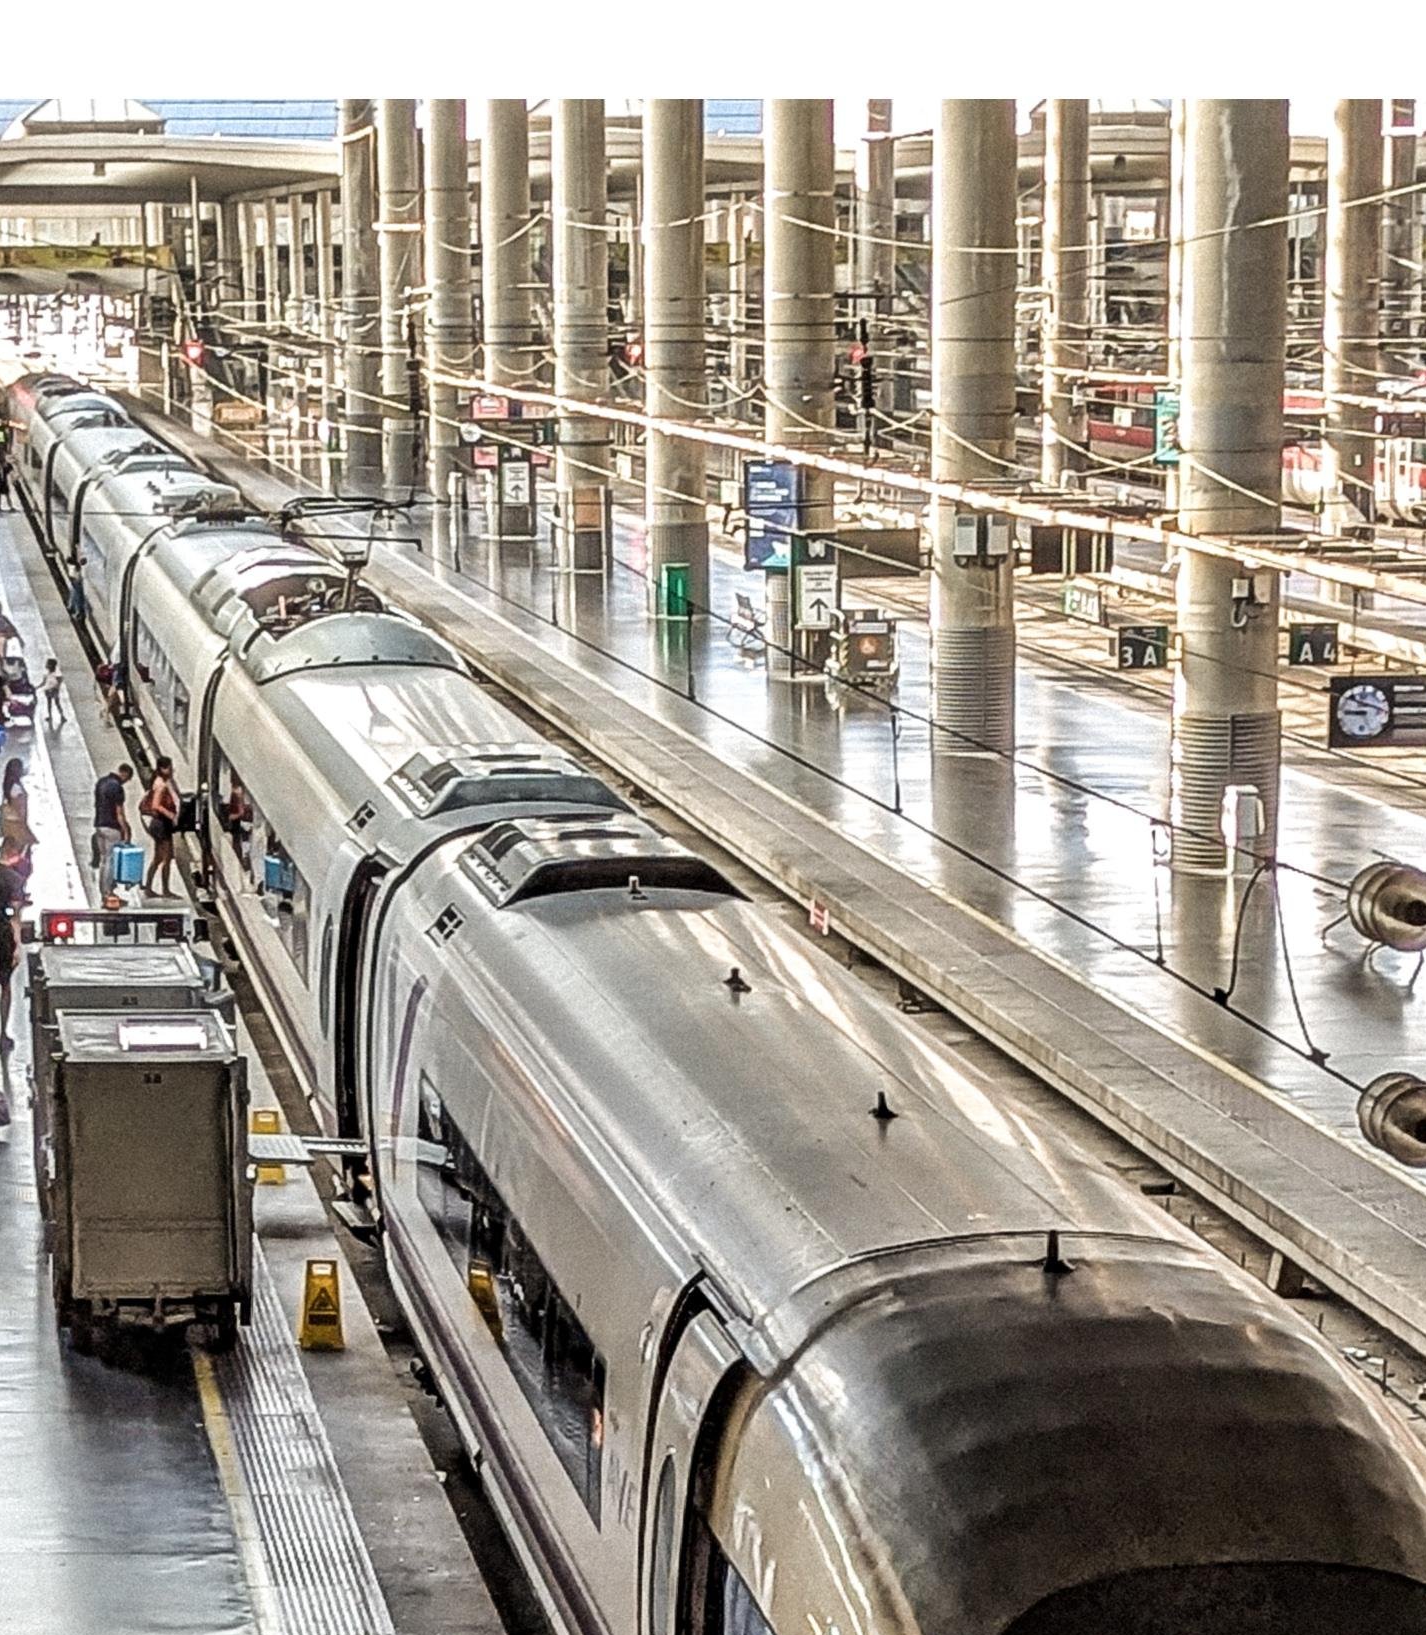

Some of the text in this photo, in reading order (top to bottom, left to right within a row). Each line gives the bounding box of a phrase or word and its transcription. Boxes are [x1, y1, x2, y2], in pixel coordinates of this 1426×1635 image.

[1121, 645, 1158, 667] 3 A
[1299, 642, 1336, 662] A 4
